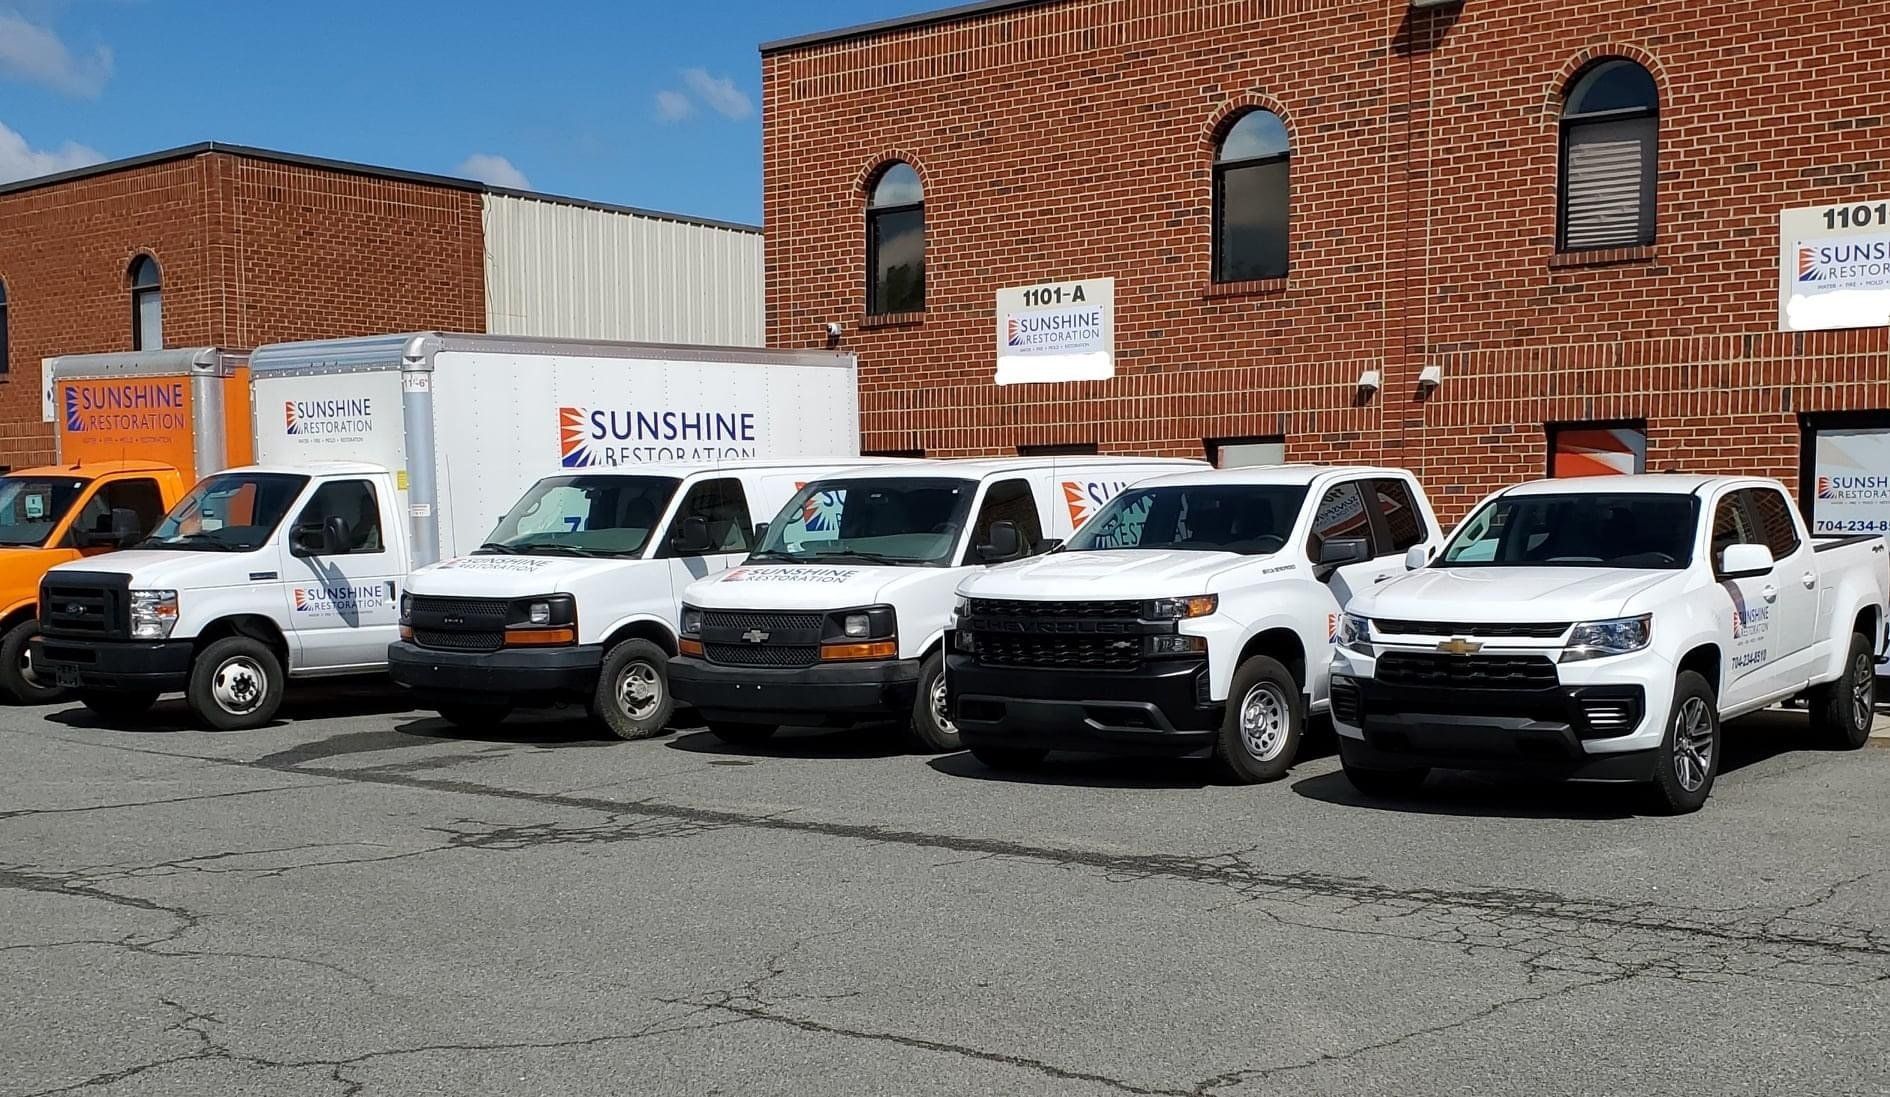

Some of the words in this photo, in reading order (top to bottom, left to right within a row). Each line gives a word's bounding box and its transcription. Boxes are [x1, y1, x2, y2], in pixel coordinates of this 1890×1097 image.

[1823, 203, 1890, 230] 1101
[1820, 242, 1890, 264] SUNS
[1023, 285, 1086, 307] 1101-A
[1021, 312, 1100, 333] SUNSHINE
[1026, 329, 1100, 345] RESTORATION
[82, 384, 183, 410] SUNSHINE
[297, 398, 371, 419] SUNSHINE
[90, 413, 185, 431] RESTORATION
[304, 420, 373, 434] RESTORATION
[591, 410, 755, 441] SUNSHINE
[1838, 488, 1890, 499] RESTORA
[1817, 520, 1890, 532] 704-234-8
[748, 568, 859, 577] SUNSHINE
[308, 585, 382, 600] SUNSHINE
[314, 599, 382, 610] RESTORATION
